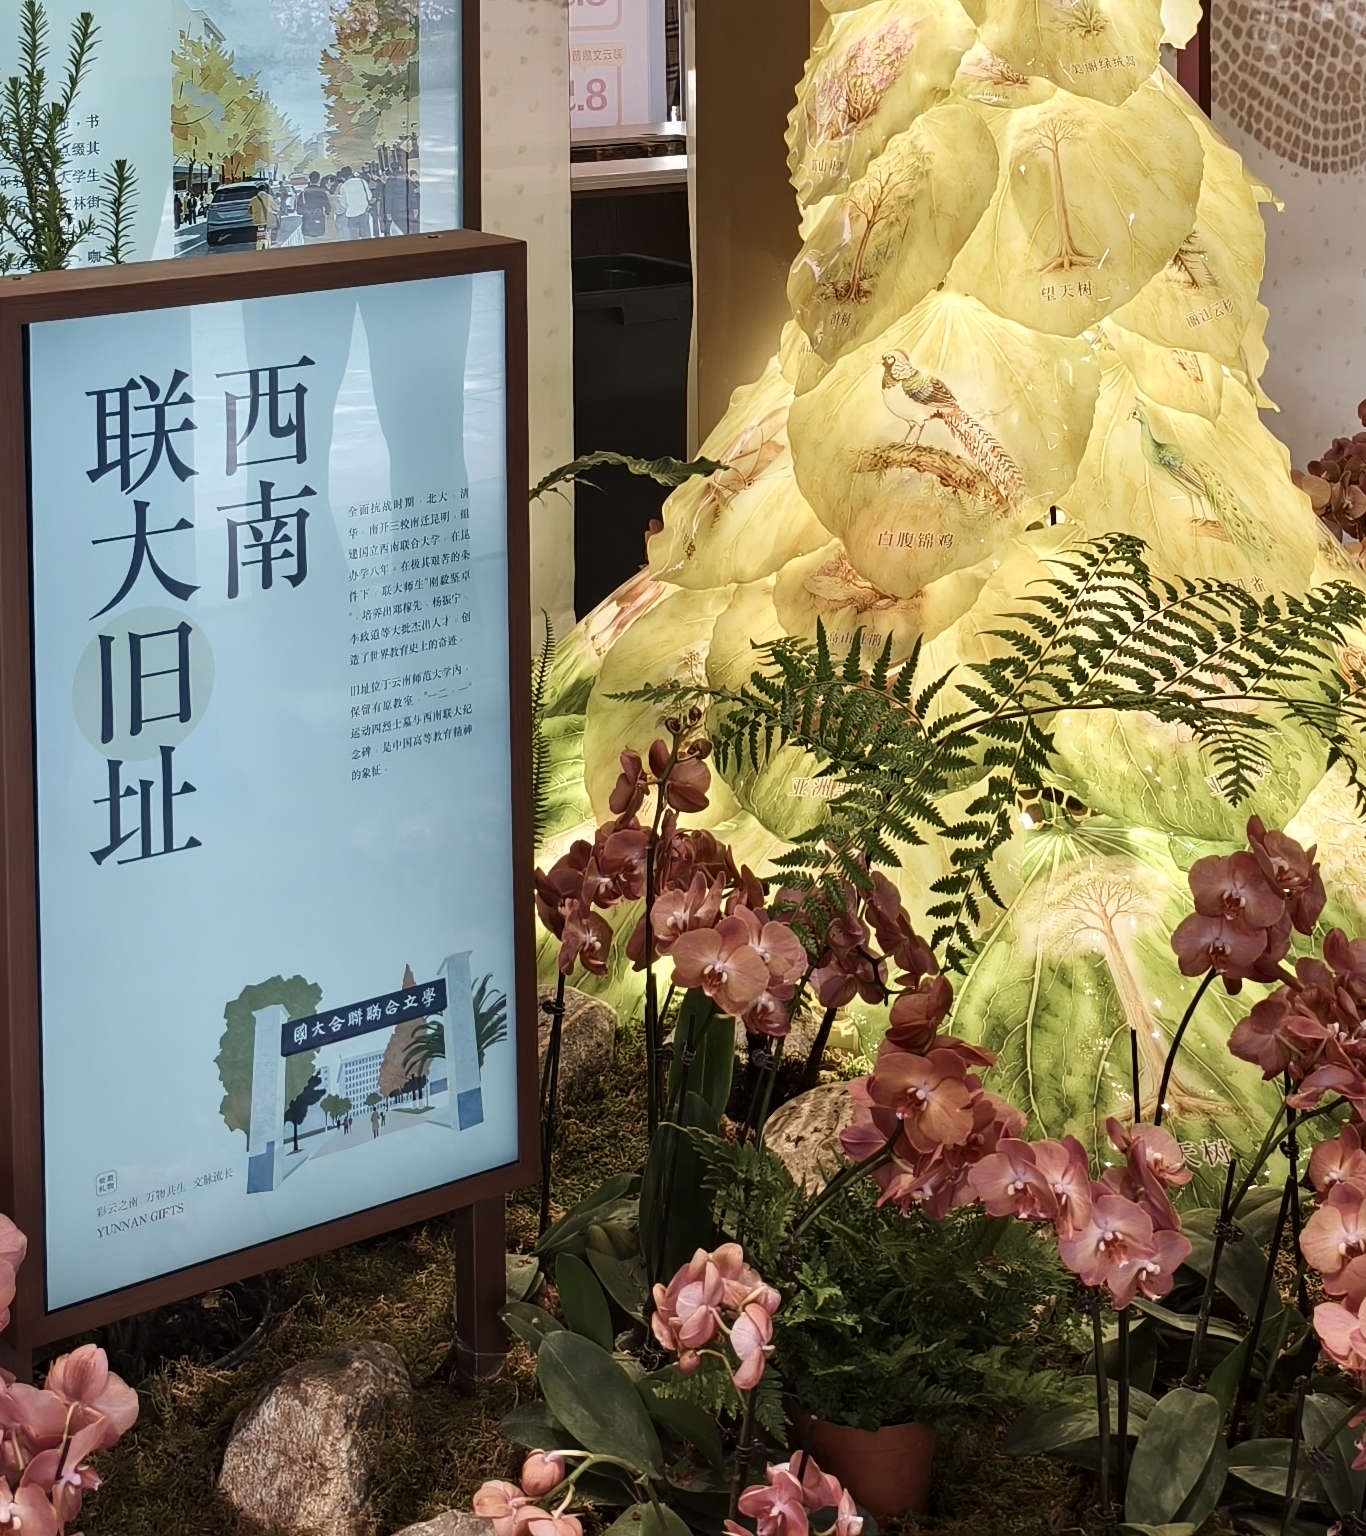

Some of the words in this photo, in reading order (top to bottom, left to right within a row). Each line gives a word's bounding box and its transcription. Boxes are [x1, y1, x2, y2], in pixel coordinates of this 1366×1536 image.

[1041, 280, 1093, 303] 望天树
[1185, 298, 1235, 330] 丽江云杉
[215, 353, 318, 601] 西南
[348, 486, 469, 517] 全面抗战时期，北大、清
[878, 531, 954, 549] 白腹锦鸡
[84, 368, 202, 866] 联大旧址
[350, 703, 473, 740] 运动四烈士墓与西南联大纪
[351, 764, 388, 782] 的象征。
[145, 1181, 187, 1203] 万物共生
[193, 1167, 234, 1189] 文脉流长
[96, 1213, 148, 1239] YUNNAN
[150, 1202, 185, 1222] GIFTS
